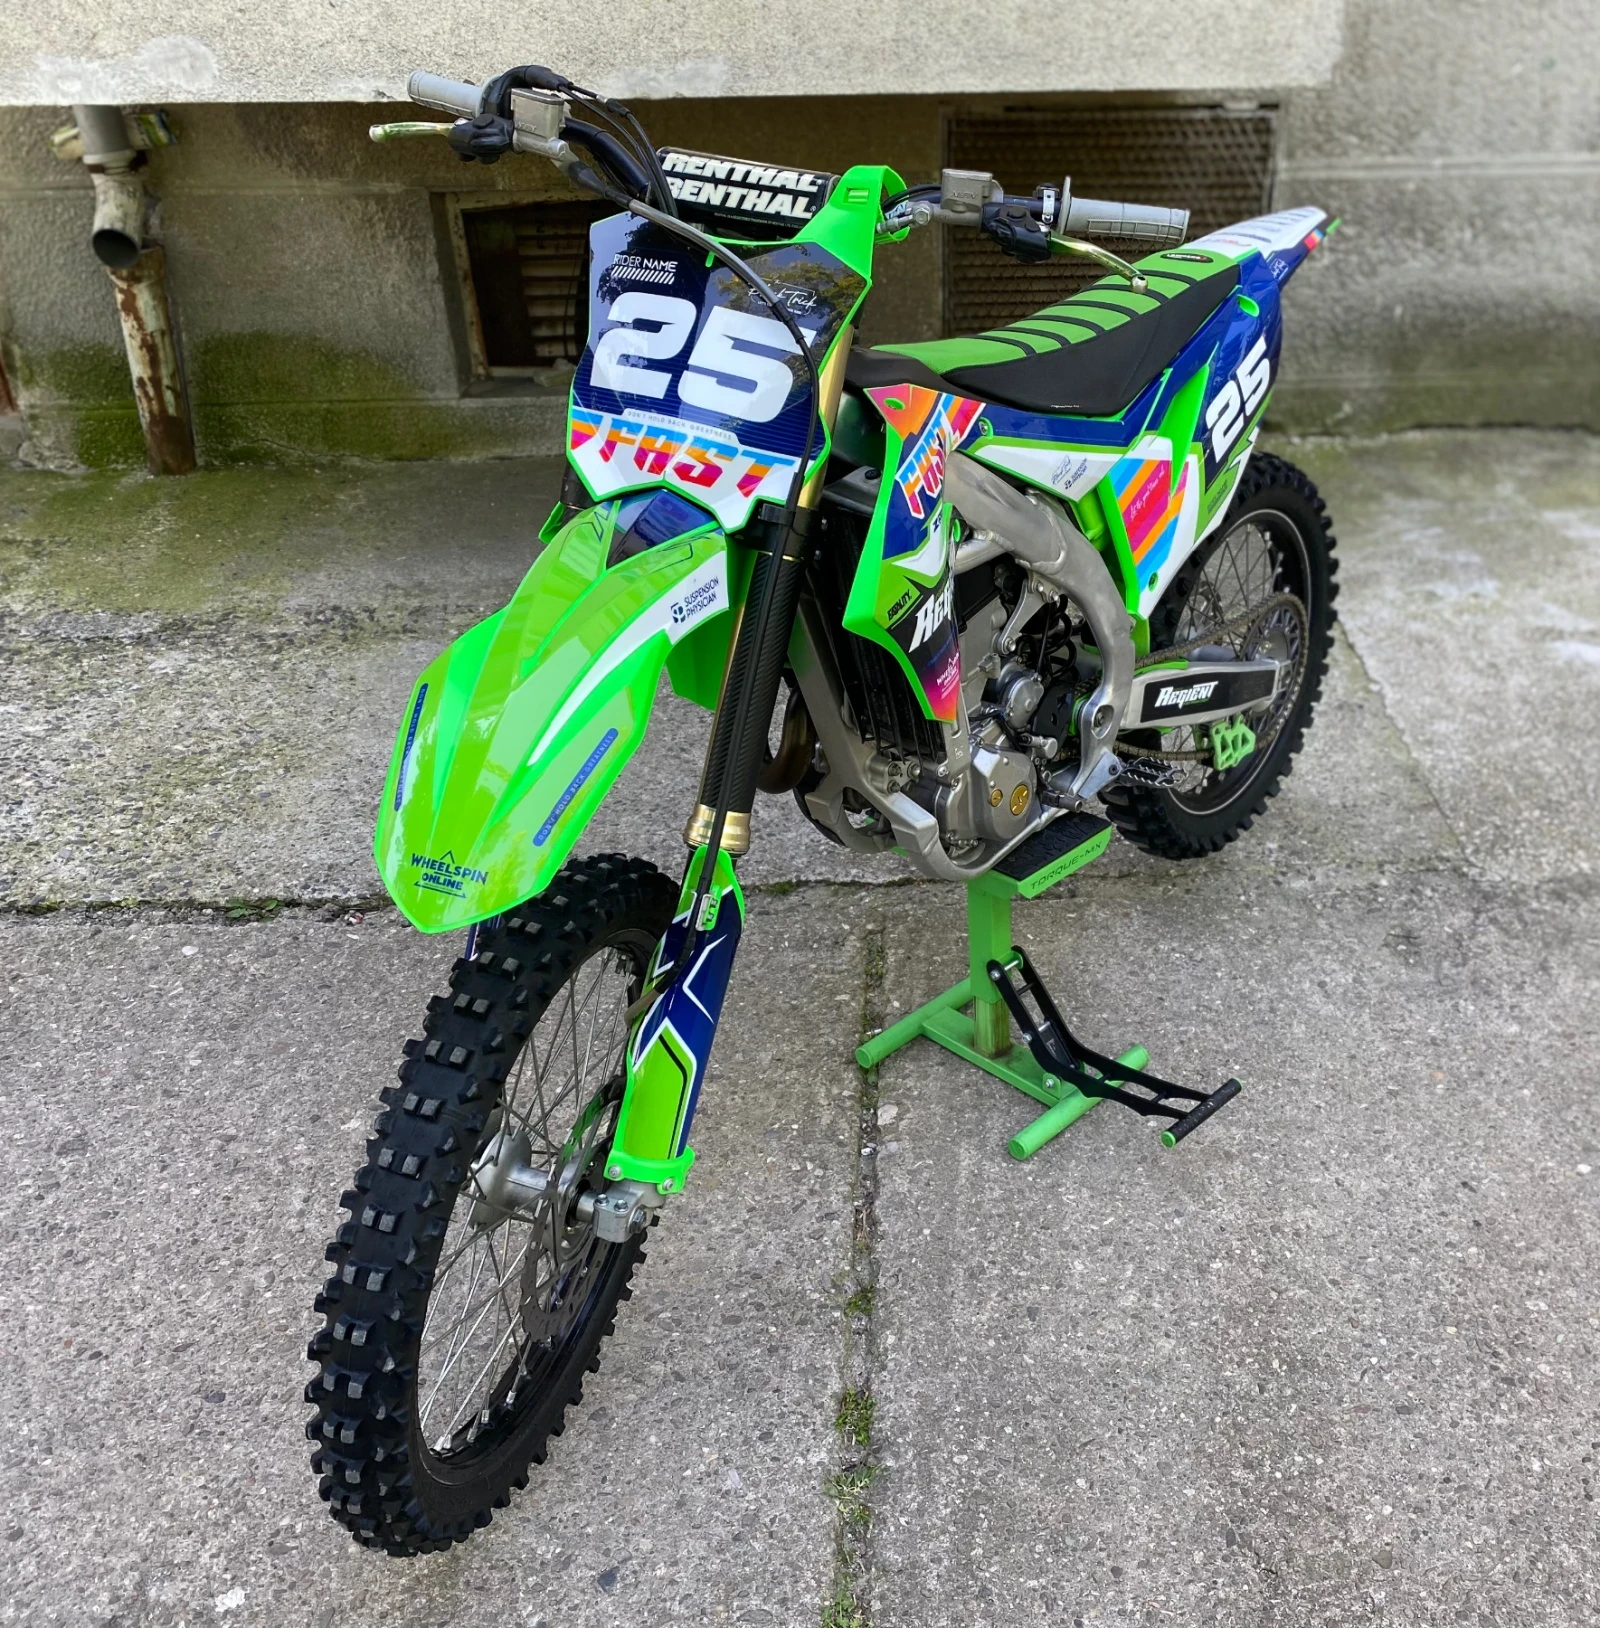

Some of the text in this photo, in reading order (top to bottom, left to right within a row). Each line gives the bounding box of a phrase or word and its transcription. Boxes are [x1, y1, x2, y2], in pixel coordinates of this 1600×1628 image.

[662, 152, 819, 193] RENTHAL
[666, 176, 815, 220] RENTHAL
[613, 253, 679, 272] RIDER NAME
[589, 291, 817, 424] 25
[1205, 333, 1271, 464] 25
[627, 410, 732, 441] DON'T HOLD BACK GREATNESS
[599, 416, 797, 498] FAST
[684, 576, 719, 608] SUSPENSION
[686, 591, 717, 618] PHYSICIAN
[554, 794, 571, 815] HOLD
[569, 775, 586, 793] BACK
[584, 735, 614, 772] GREATNESS
[411, 853, 489, 886] WHEELSPIN
[421, 872, 464, 891] ONLINE
[1030, 841, 1102, 890] TORQUE-MX
